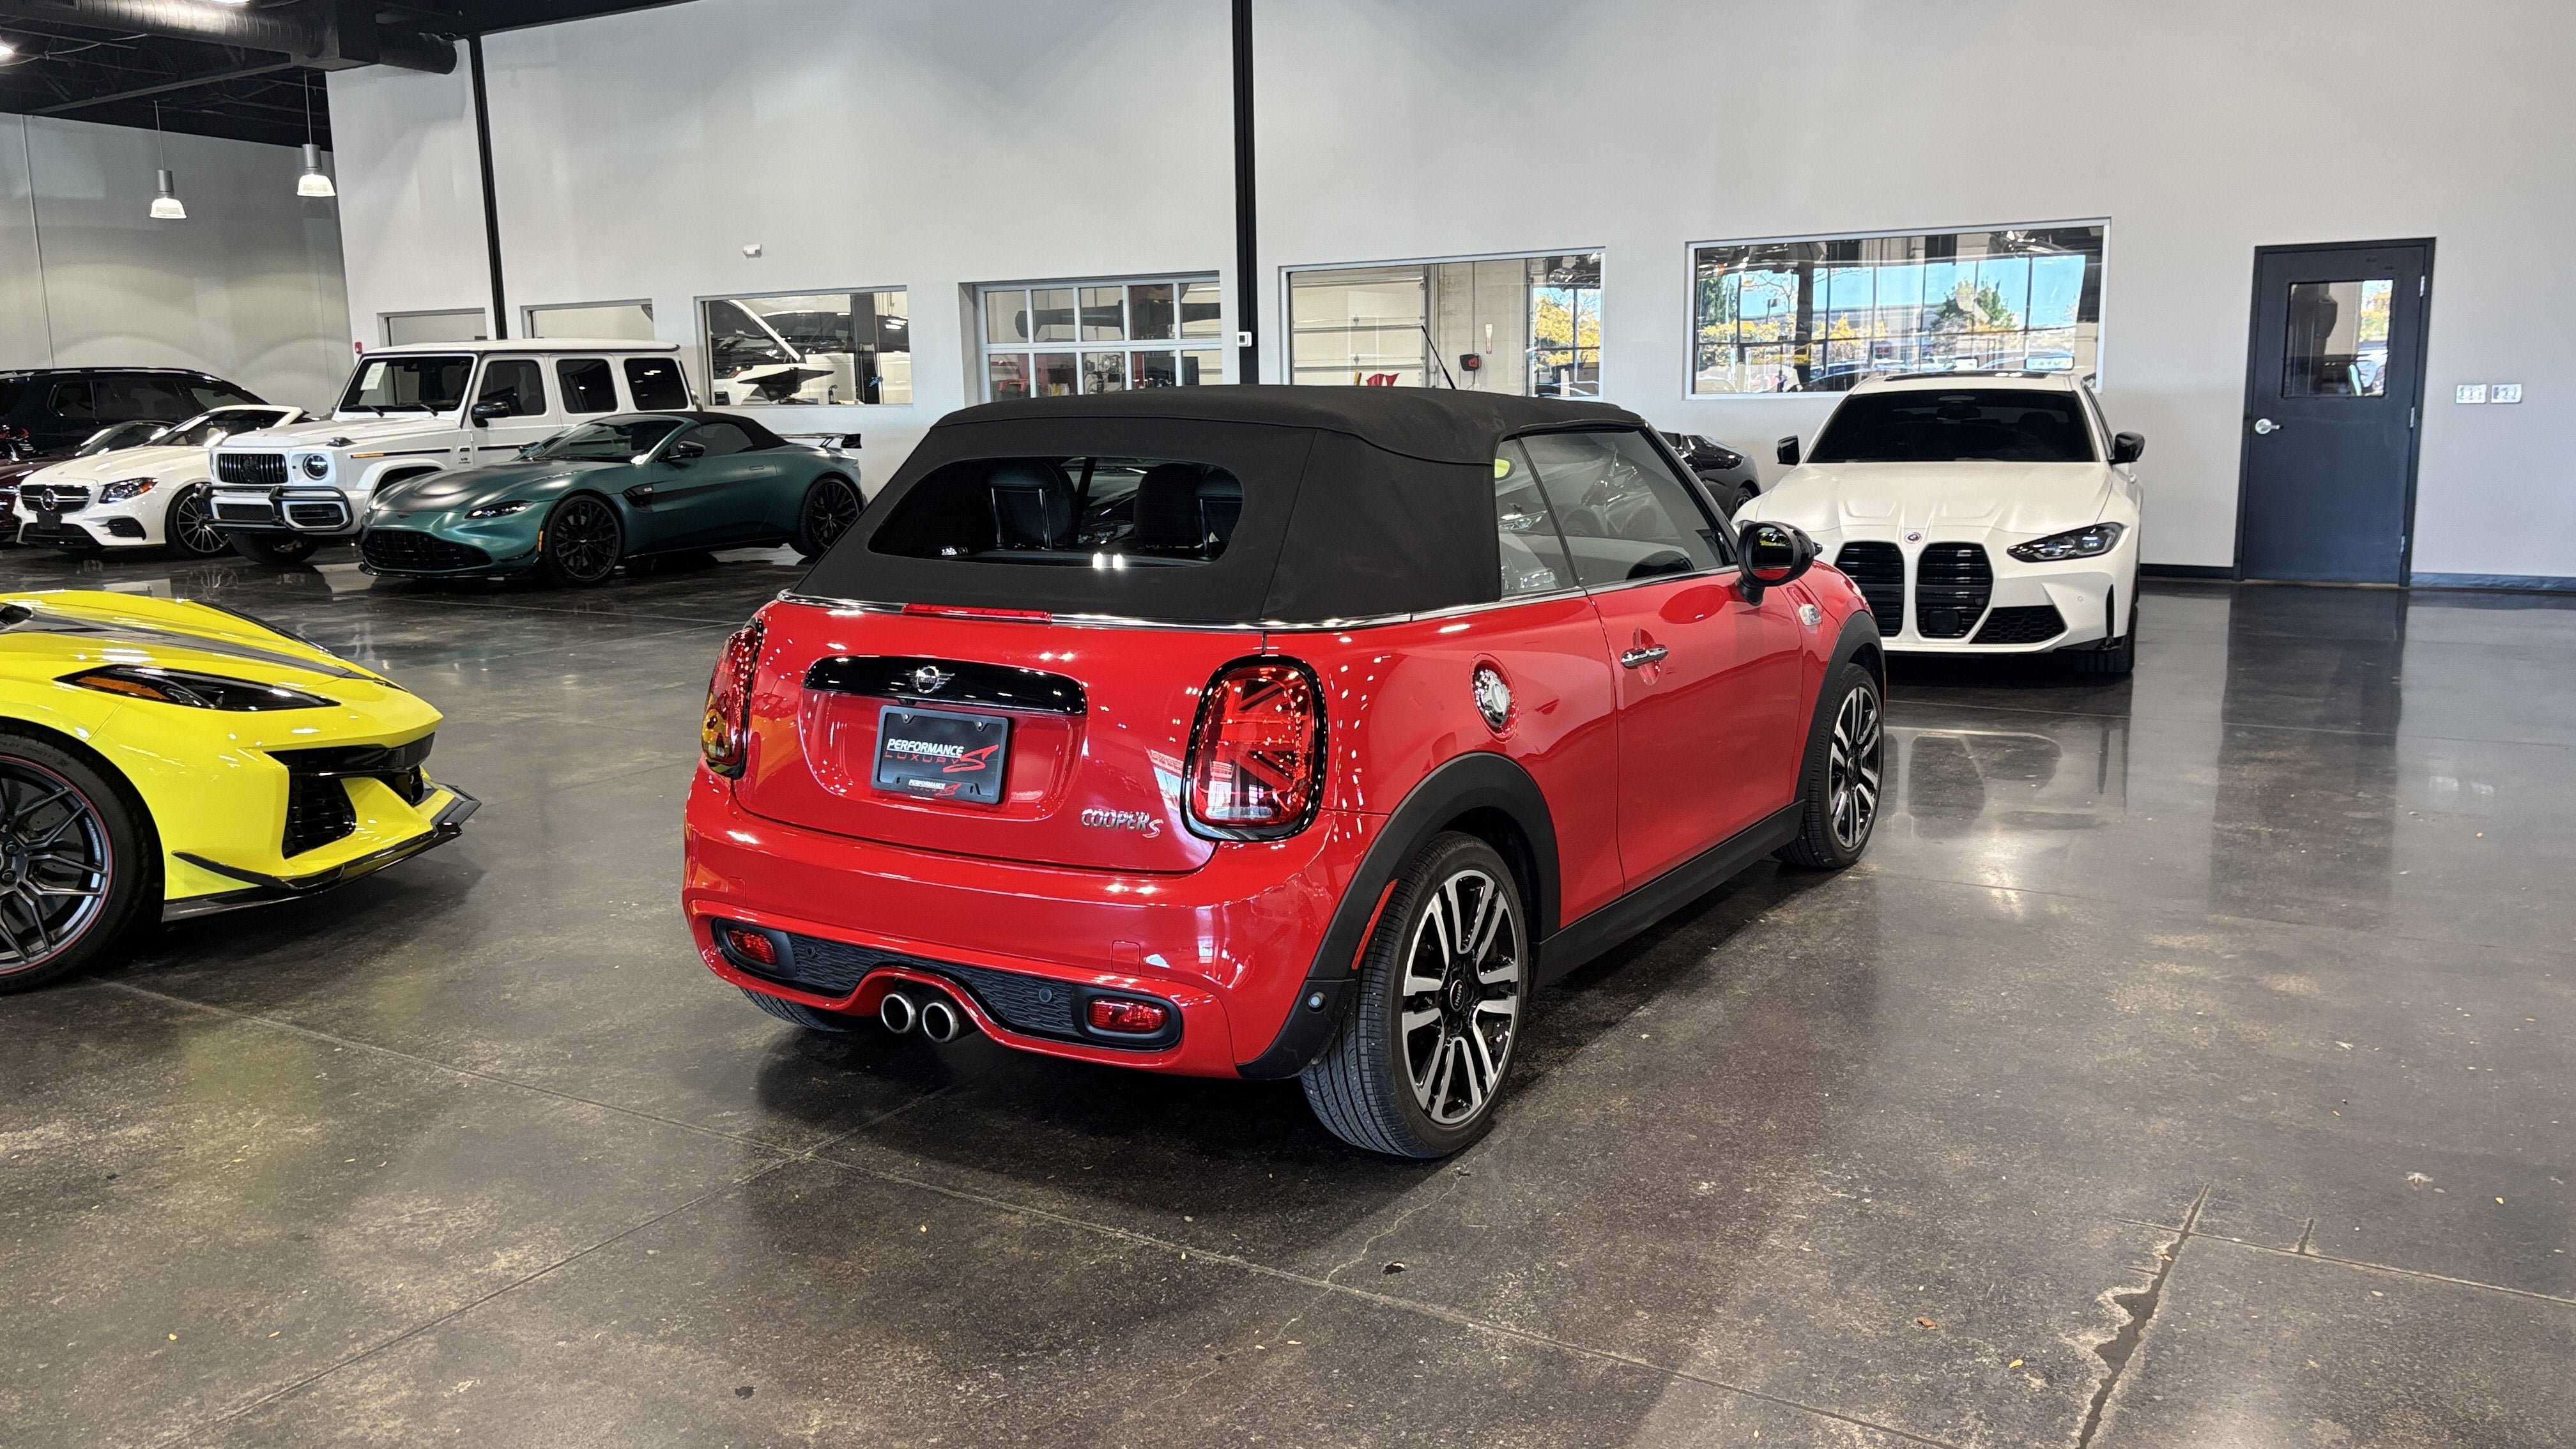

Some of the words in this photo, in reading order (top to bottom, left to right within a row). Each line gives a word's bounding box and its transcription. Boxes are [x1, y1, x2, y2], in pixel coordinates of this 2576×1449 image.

[887, 739, 964, 756] PERFORMANCE
[885, 751, 959, 765] LUXURY
[908, 779, 946, 789] PERFORMANCE
[1081, 808, 1150, 831] COOPER
